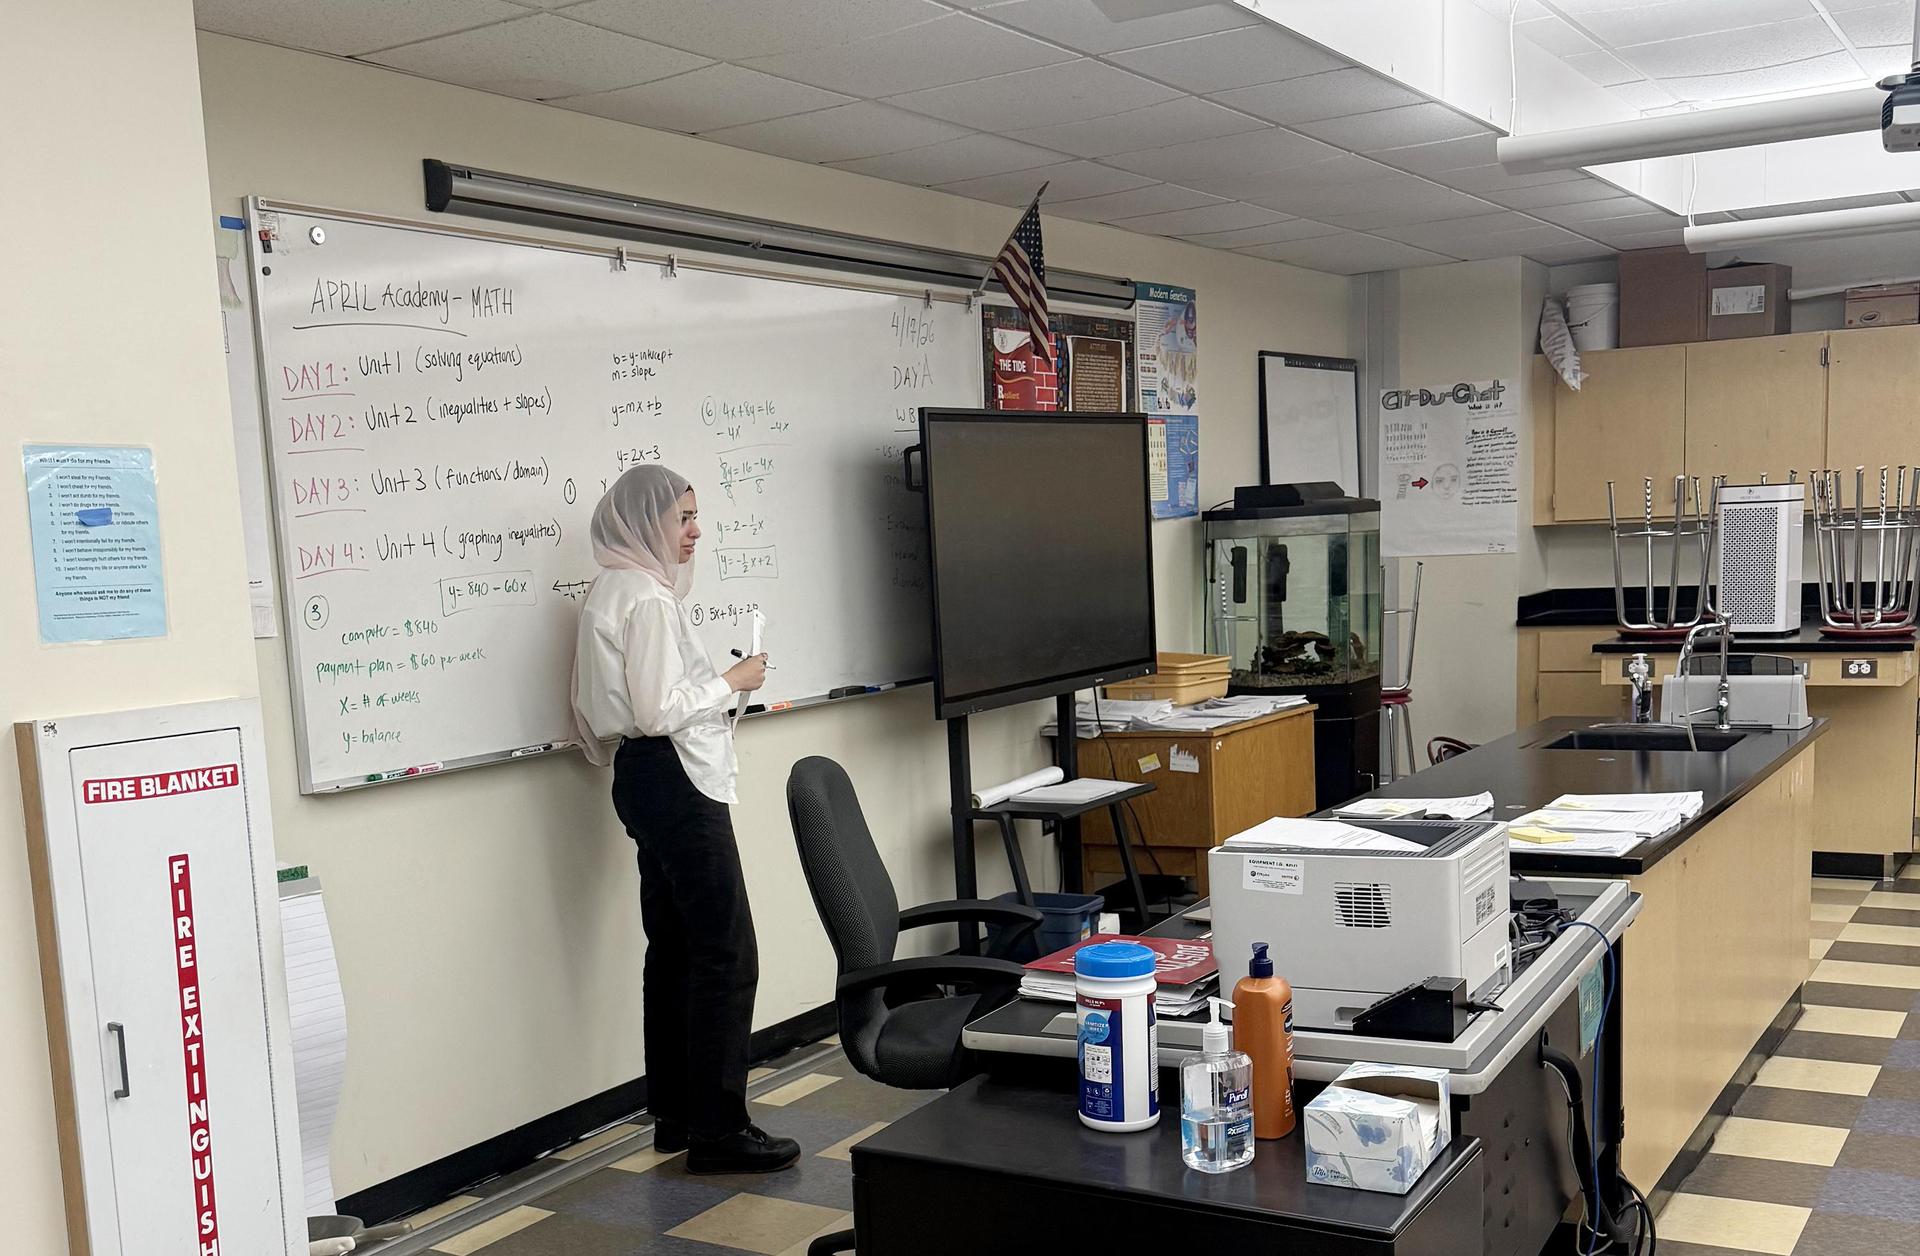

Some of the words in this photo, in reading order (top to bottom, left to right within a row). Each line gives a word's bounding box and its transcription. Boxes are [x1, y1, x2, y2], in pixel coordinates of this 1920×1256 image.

[311, 278, 377, 314] APRIL
[471, 286, 513, 318] MATH
[1149, 286, 1169, 299] Modern
[1169, 290, 1188, 303] Genetics
[284, 363, 320, 391] DAY
[359, 350, 392, 376] Unit
[416, 345, 462, 382] (solving
[468, 344, 523, 373] equations)
[631, 365, 656, 381] slope
[1000, 358, 1012, 372] THE
[1012, 359, 1027, 373] TIDE
[289, 413, 325, 442] DAY
[365, 403, 400, 431] Unit
[405, 406, 417, 423] 2
[426, 396, 498, 422] (inequalities
[516, 386, 552, 416] slopes)
[293, 477, 331, 505] DAY
[371, 469, 410, 495] Unit
[413, 468, 427, 491] 3
[298, 545, 338, 572] DAY
[376, 533, 416, 562] Unit
[422, 531, 436, 557] 4
[342, 625, 390, 645] computer
[404, 619, 439, 636] $840
[368, 657, 393, 680] plan
[409, 653, 436, 670] $60
[440, 655, 457, 671] per
[459, 647, 487, 663] week
[391, 690, 421, 704] weeks
[362, 729, 402, 744] balance
[87, 779, 136, 802] FIRE
[140, 766, 236, 797] BLANKET
[172, 859, 195, 968] FIRE
[183, 985, 221, 1256] EXTINGUISH
